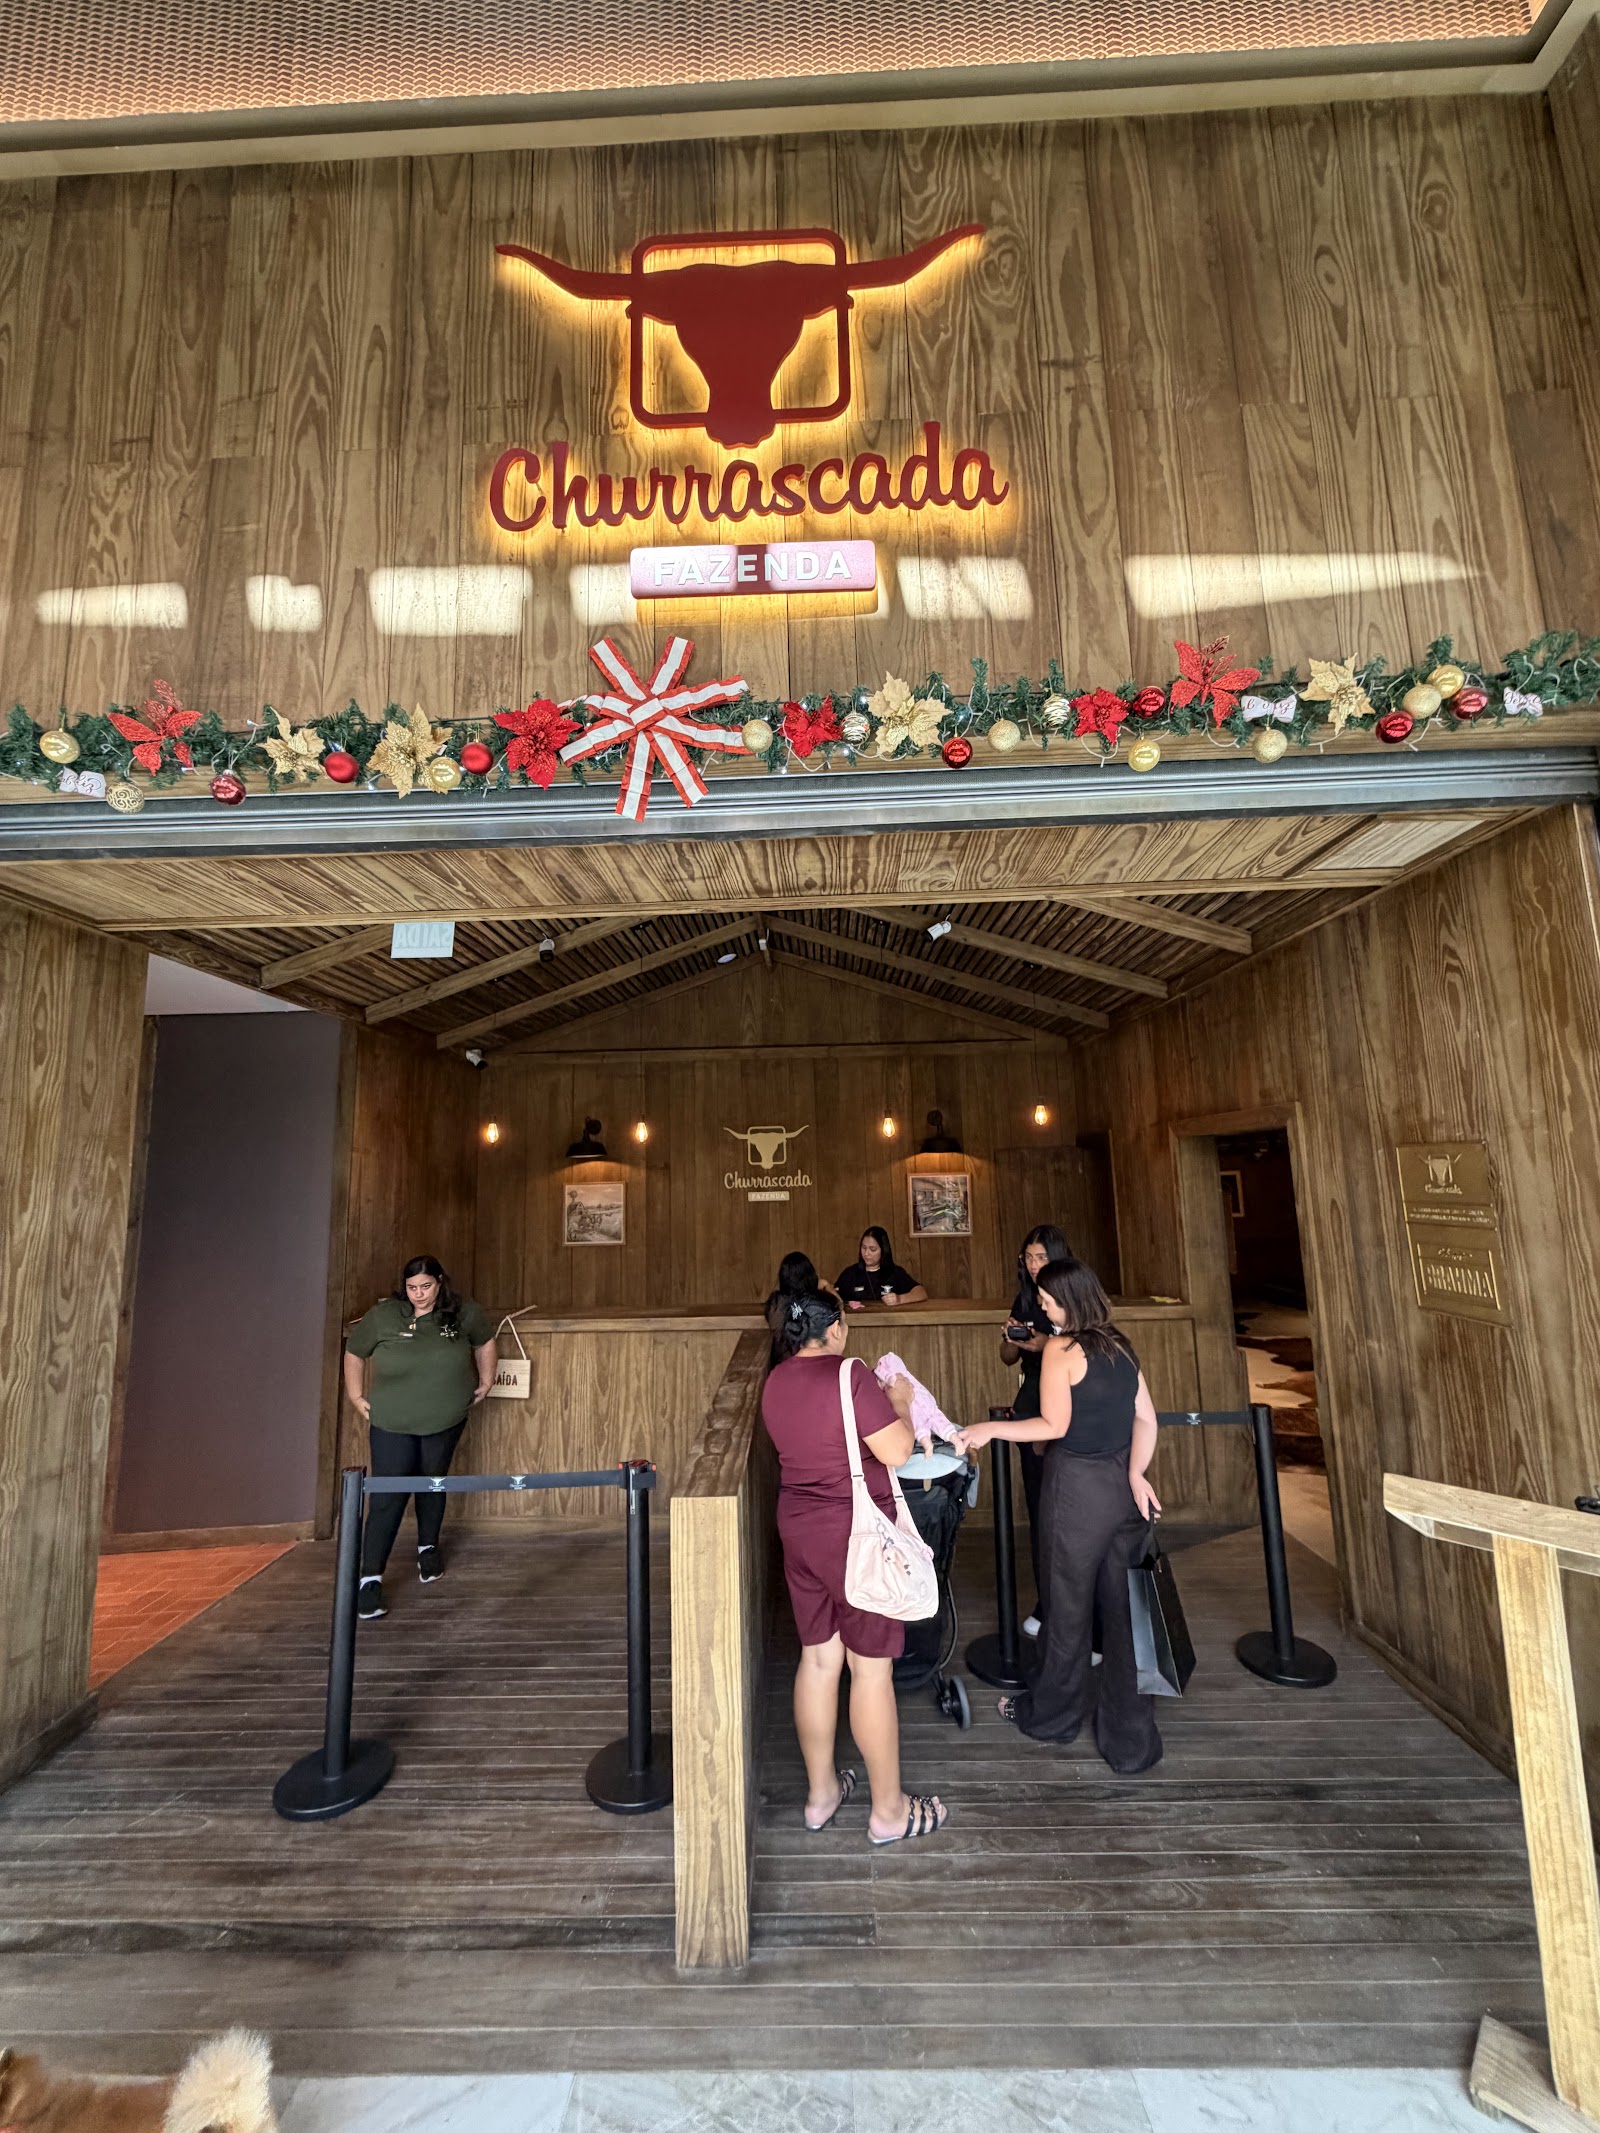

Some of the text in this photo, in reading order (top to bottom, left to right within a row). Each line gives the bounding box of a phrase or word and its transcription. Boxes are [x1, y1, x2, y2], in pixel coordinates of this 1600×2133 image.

[489, 420, 1010, 532] Churrascada
[653, 548, 853, 588] FAZENDA
[723, 1169, 813, 1190] Churrascada
[751, 1191, 786, 1201] FAZENDA
